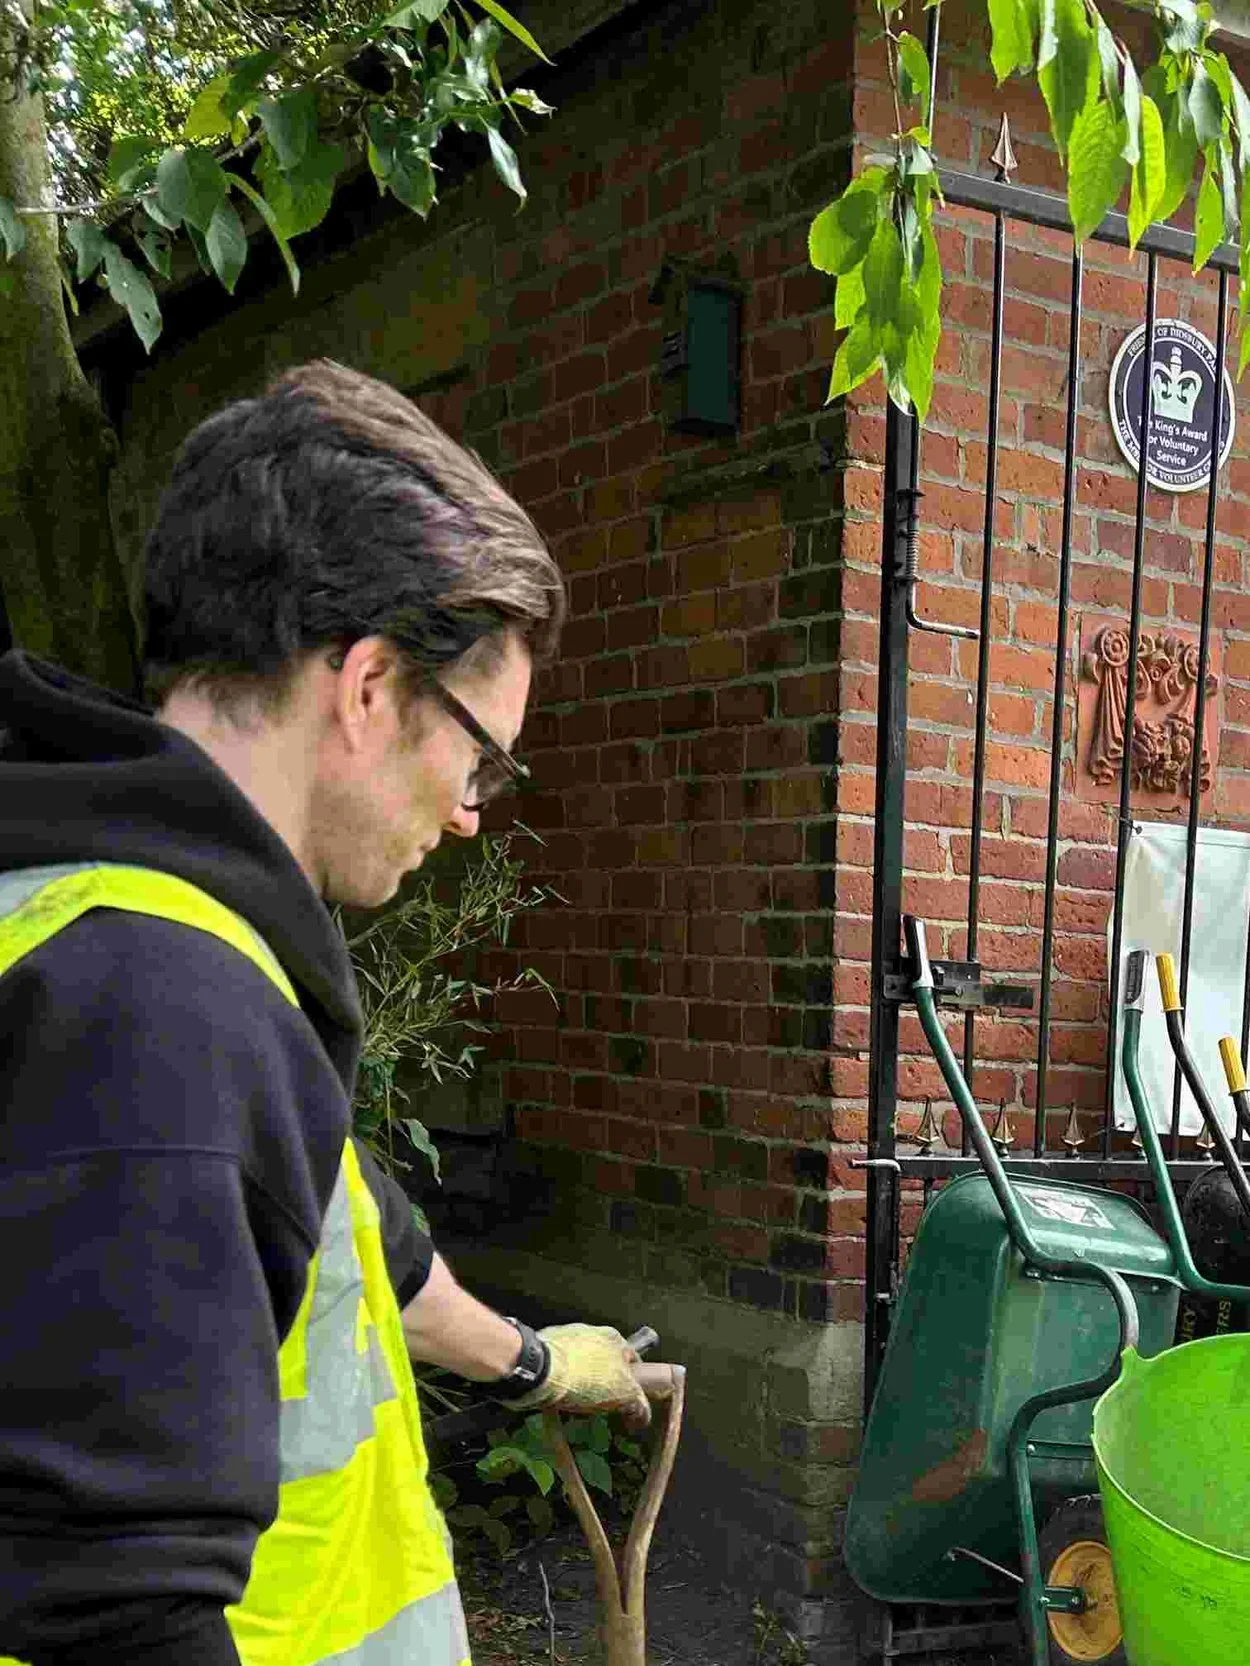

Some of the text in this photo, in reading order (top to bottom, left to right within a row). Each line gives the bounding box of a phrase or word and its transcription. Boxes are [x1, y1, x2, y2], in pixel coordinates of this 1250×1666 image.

[1157, 327, 1168, 337] OF
[1170, 327, 1206, 354] DIDSBURY
[1138, 415, 1207, 442] Te King's Award
[1147, 435, 1199, 457] or Voluntary
[1156, 449, 1187, 467] Service
[1159, 467, 1204, 483] VOLUNTEER
